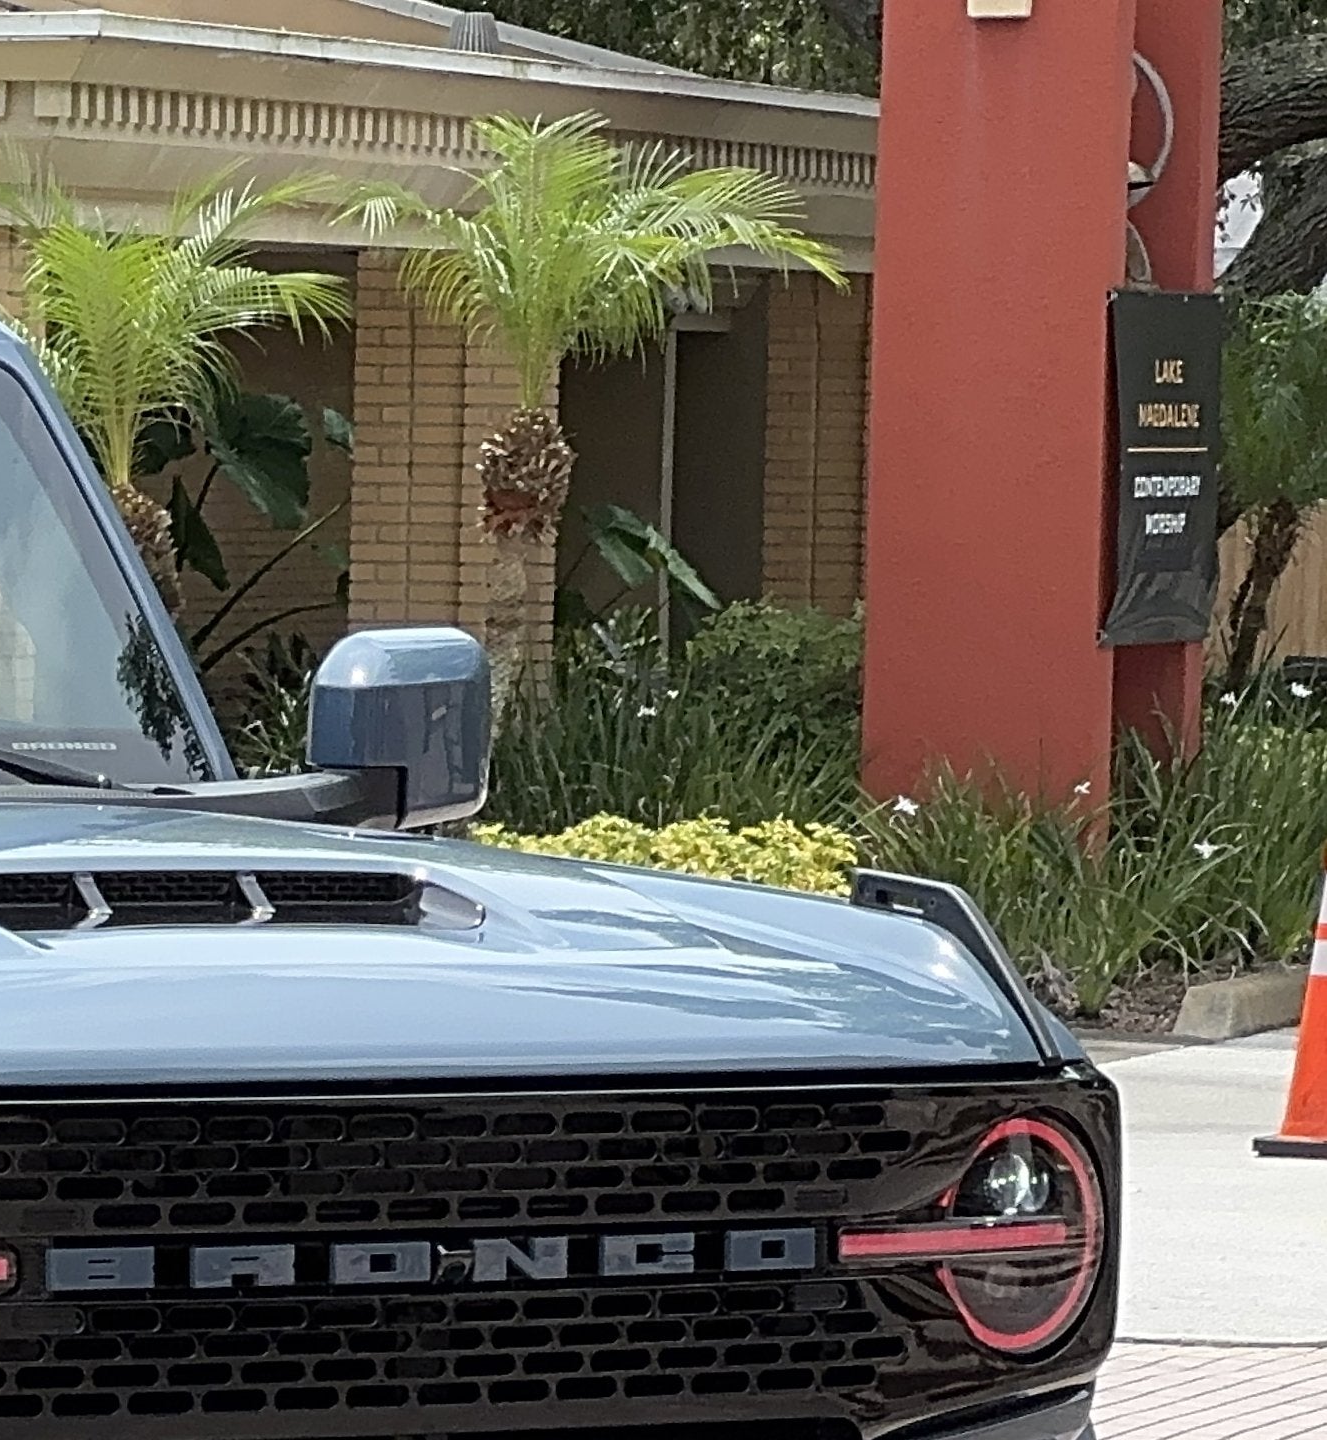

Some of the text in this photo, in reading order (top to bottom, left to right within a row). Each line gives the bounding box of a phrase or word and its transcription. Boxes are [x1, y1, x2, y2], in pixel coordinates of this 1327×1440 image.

[1154, 359, 1184, 384] LAKE
[1138, 403, 1200, 428] MAGDALENE
[1134, 475, 1201, 498] CONTEMPORARY
[44, 1227, 818, 1291] BRONCO
